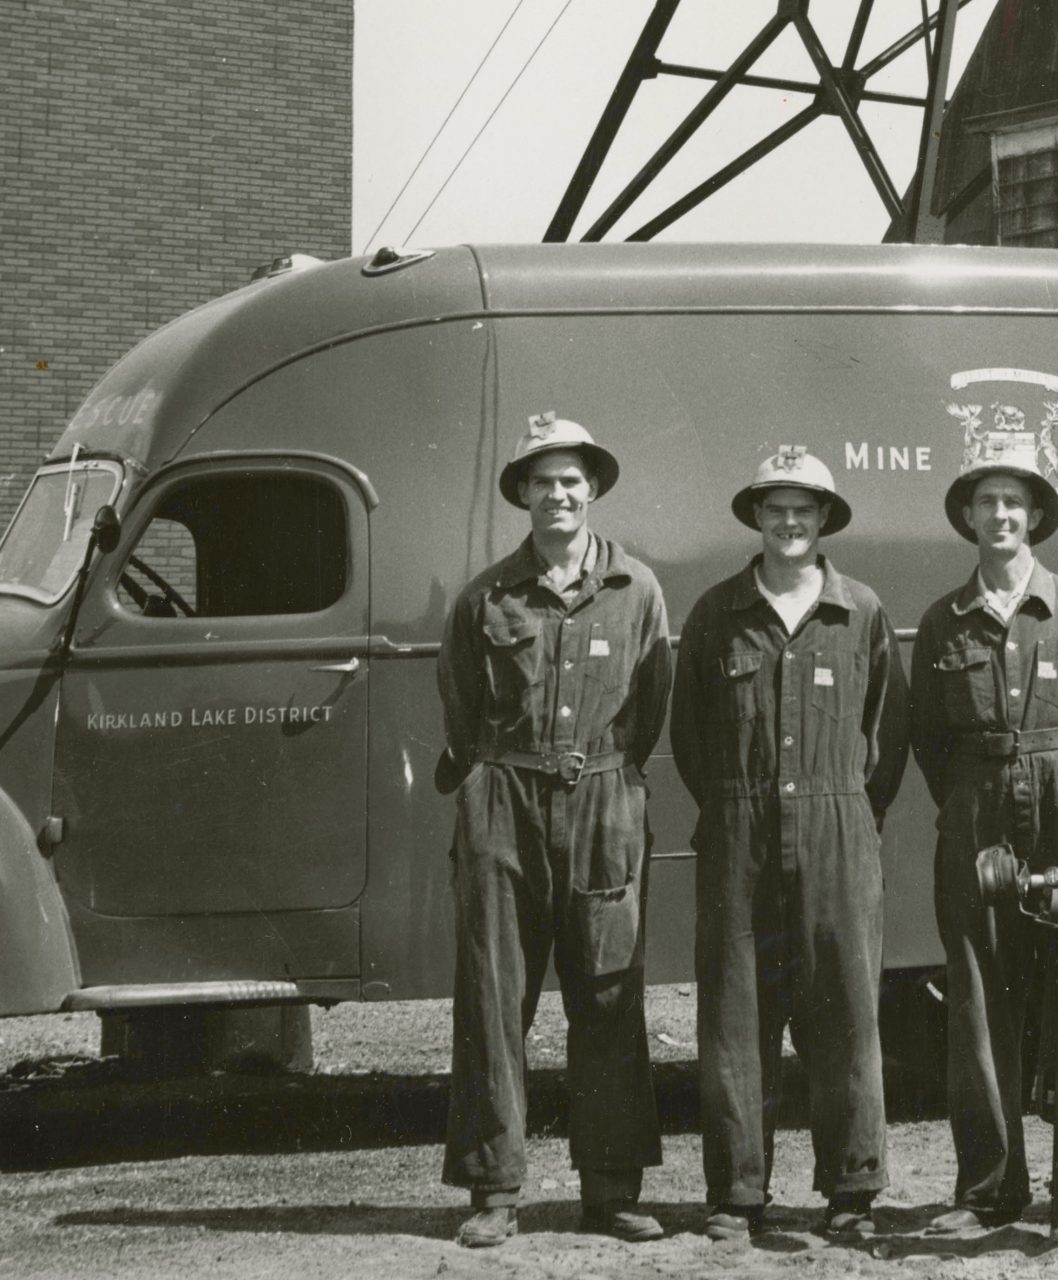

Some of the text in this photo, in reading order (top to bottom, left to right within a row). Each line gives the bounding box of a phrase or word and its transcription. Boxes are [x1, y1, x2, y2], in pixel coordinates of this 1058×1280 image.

[844, 441, 933, 471] MINE
[87, 705, 334, 730] KIRKLAND LAKE DISTRICT
